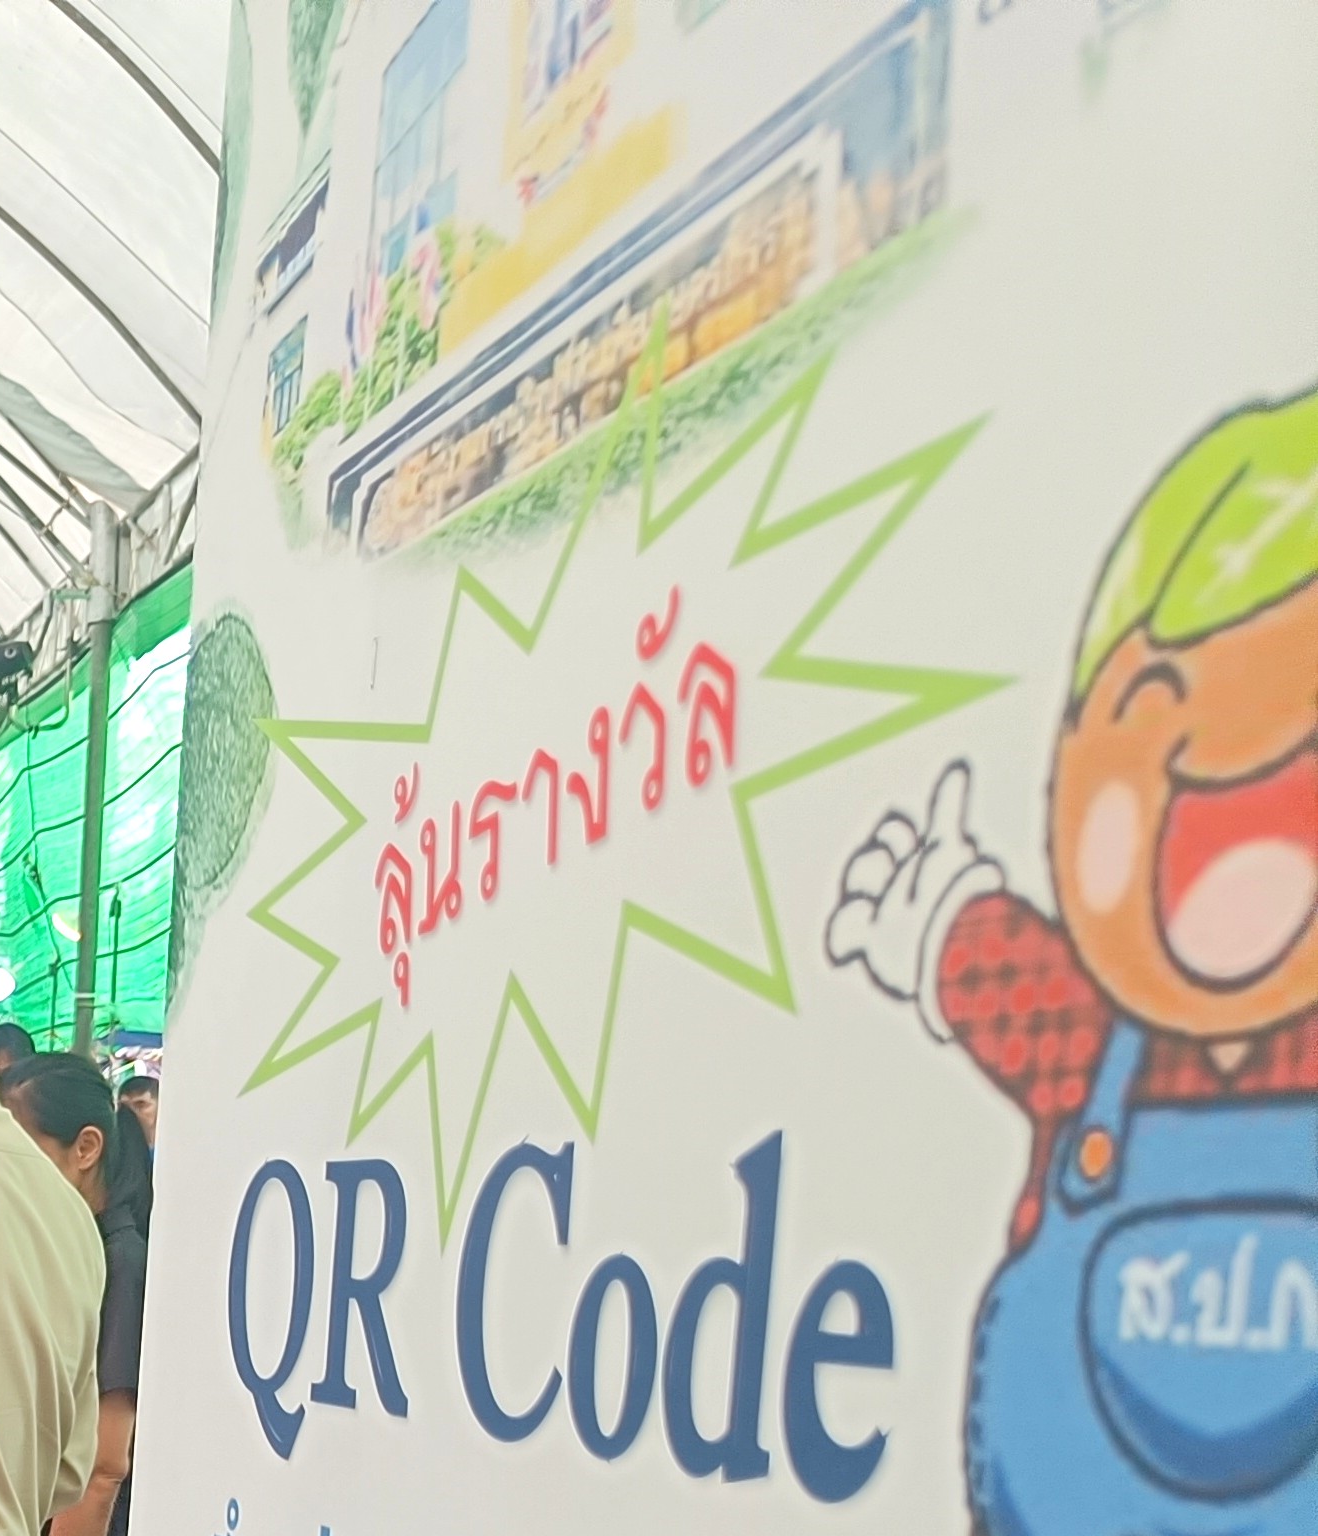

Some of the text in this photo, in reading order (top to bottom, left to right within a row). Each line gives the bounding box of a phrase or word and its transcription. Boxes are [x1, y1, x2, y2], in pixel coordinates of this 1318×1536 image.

[375, 583, 736, 1008] ลุ้นรางวัล
[226, 1130, 895, 1504] QR Code
